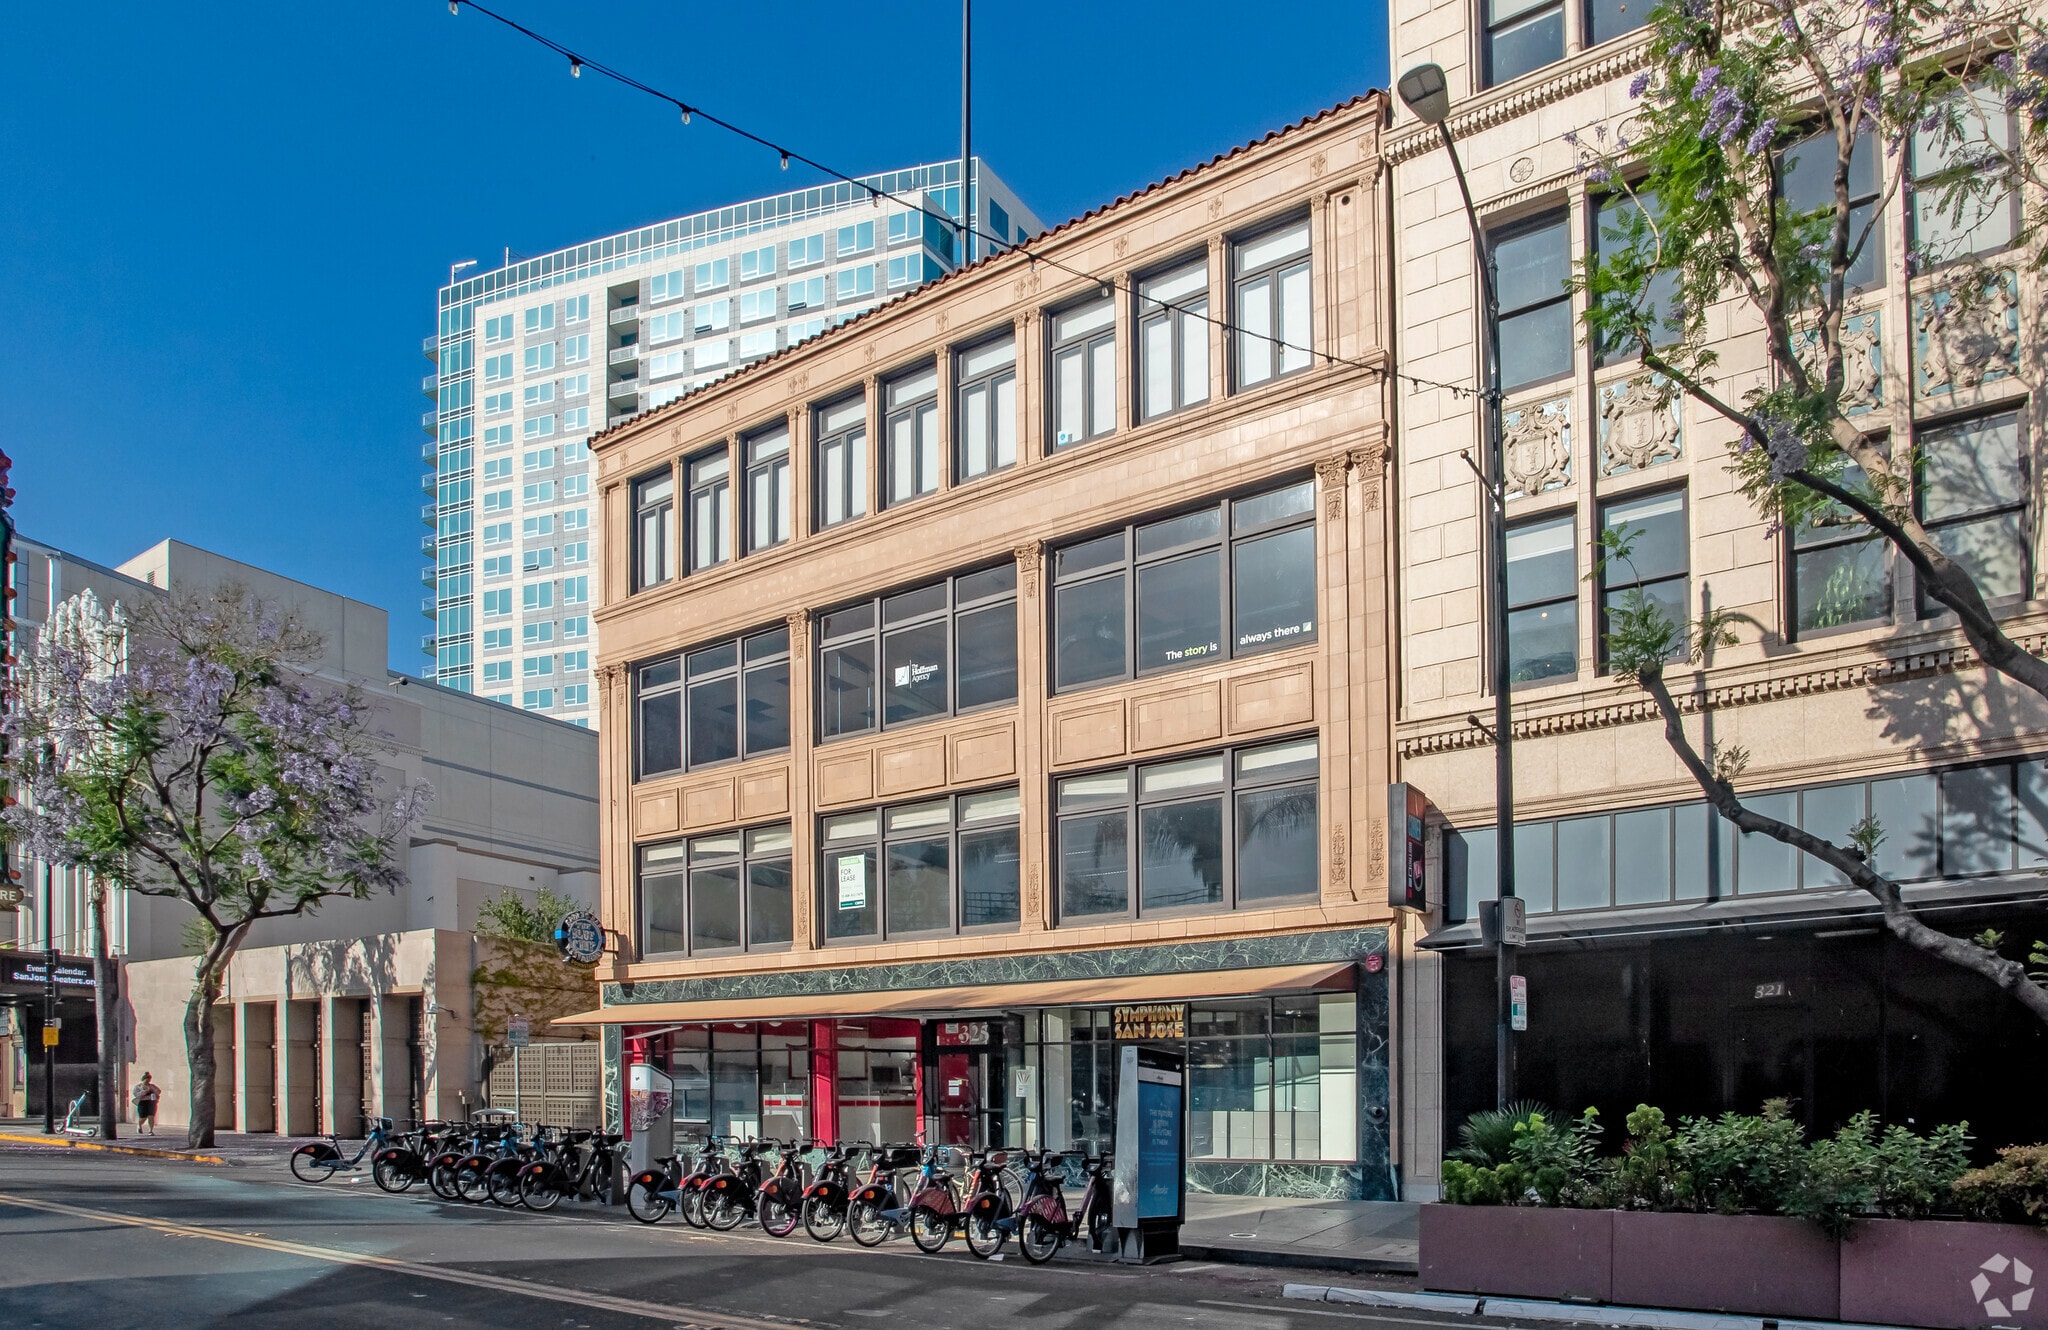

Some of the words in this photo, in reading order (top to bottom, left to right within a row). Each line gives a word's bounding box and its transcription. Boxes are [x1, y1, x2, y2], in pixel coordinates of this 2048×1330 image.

[1165, 649, 1183, 661] The
[1184, 645, 1208, 657] story
[1209, 641, 1218, 652] is
[1239, 630, 1273, 645] always
[1273, 624, 1300, 638] there
[911, 664, 939, 676] Hoffman
[911, 672, 931, 683] Agency
[840, 868, 852, 876] FOR
[840, 875, 856, 883] LEASE
[1754, 984, 1782, 999] 321
[1114, 1004, 1185, 1023] SYMPHONY
[958, 1023, 990, 1044] 325
[1114, 1022, 1146, 1039] SAN
[1149, 1021, 1185, 1039] JOSE
